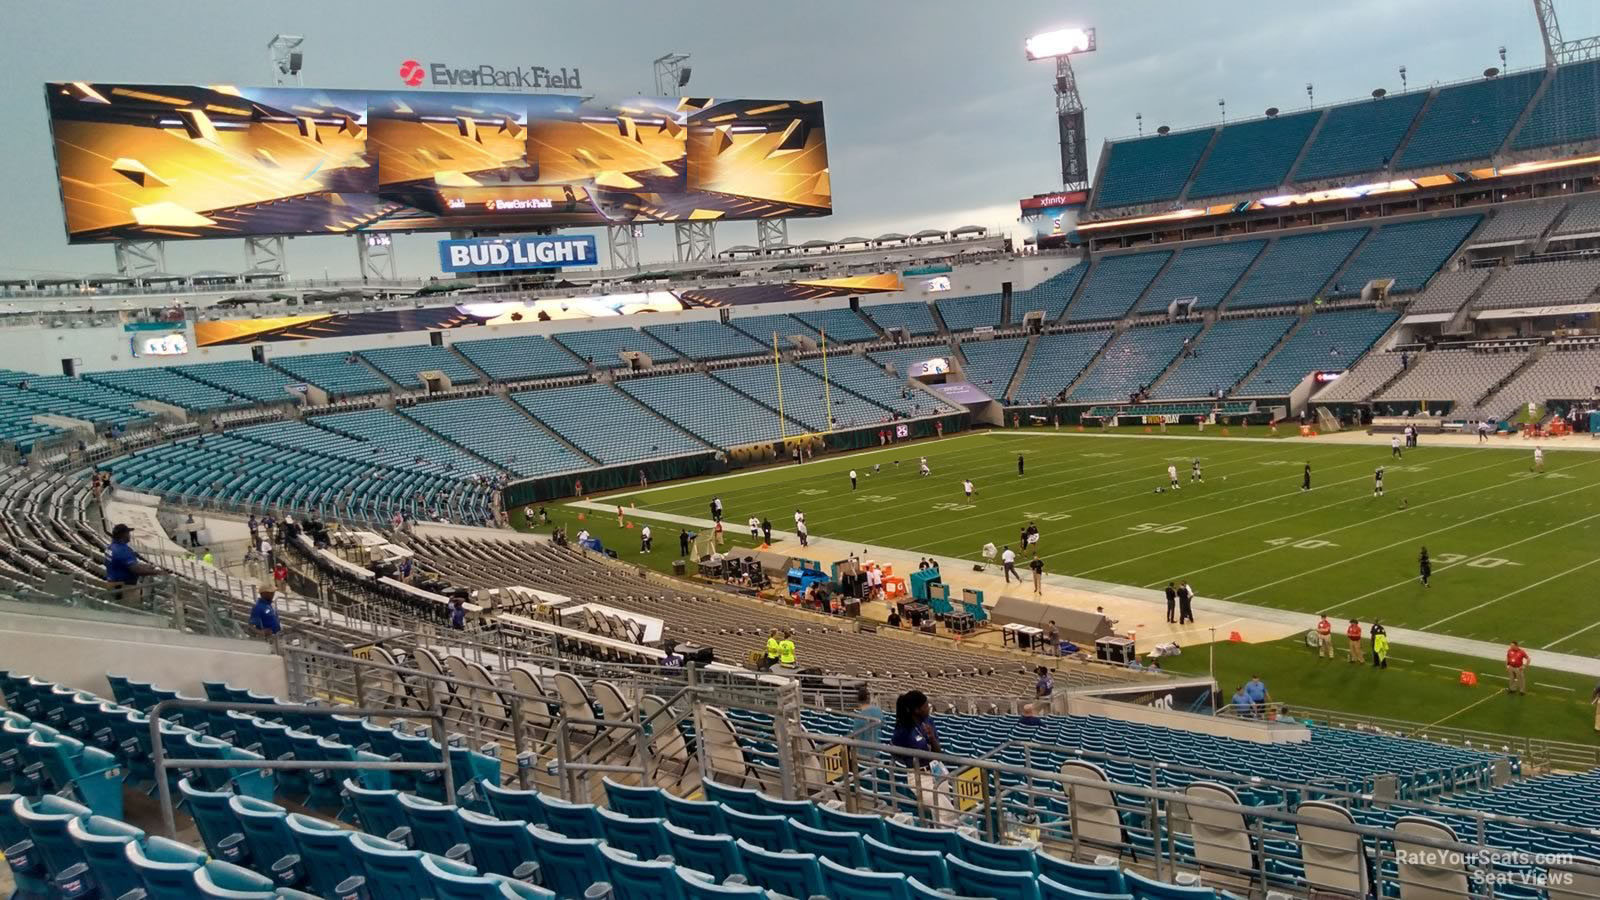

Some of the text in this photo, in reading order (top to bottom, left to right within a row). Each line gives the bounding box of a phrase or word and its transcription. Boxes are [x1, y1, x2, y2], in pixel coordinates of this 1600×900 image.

[1040, 196, 1066, 206] xfinity
[450, 240, 587, 267] BUD LIGHT
[1127, 522, 1188, 534] 50
[1264, 537, 1329, 549] 40
[1430, 553, 1508, 568] 30
